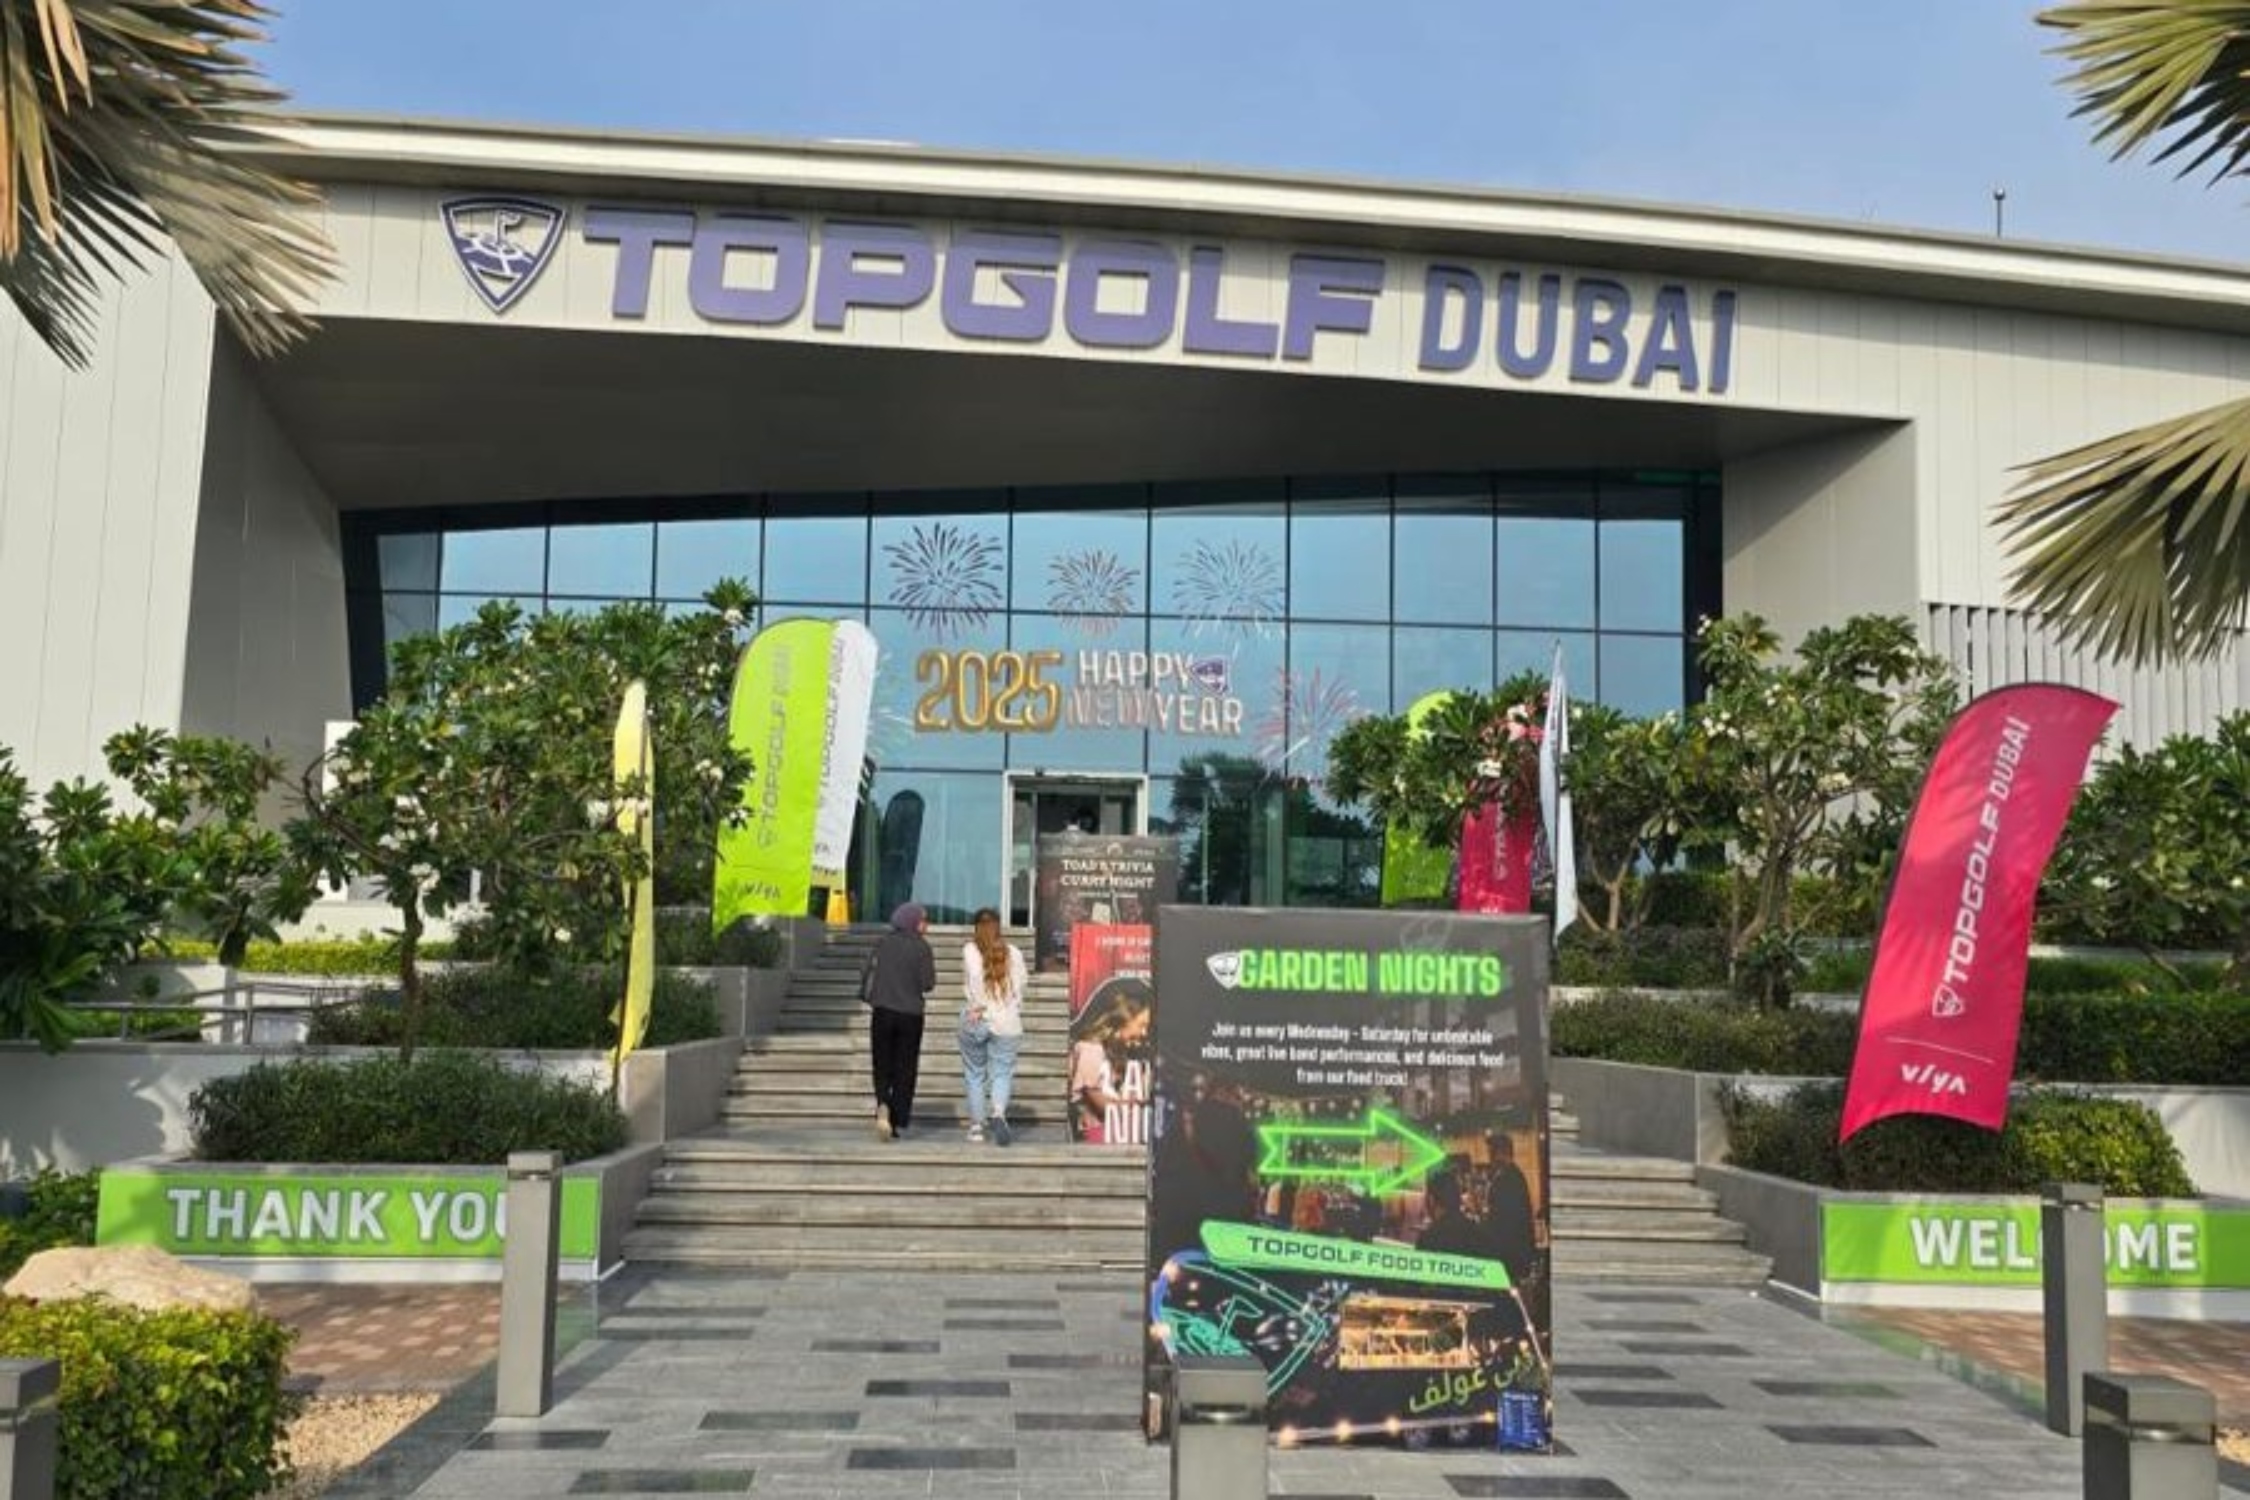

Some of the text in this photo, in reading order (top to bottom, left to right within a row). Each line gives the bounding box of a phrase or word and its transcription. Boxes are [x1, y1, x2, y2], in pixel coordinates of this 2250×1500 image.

[583, 205, 1738, 395] TOPGOLF DUBAI
[916, 649, 1193, 733] 2025 HAPPY
[1151, 693, 1244, 735] YEAR
[1943, 716, 2030, 985] TOPGOLF DUBAI
[1238, 949, 1501, 997] GARDEN NIGHTS
[1237, 1045, 1265, 1062] great
[1320, 1048, 1400, 1066] performances,
[1404, 1051, 1424, 1065] and
[1427, 1051, 1476, 1066] delicious
[1239, 1026, 1252, 1038] us
[1254, 1026, 1285, 1042] every
[1287, 1023, 1349, 1043] Wednesday
[1361, 1027, 1410, 1045] Saturday
[1297, 1067, 1323, 1084] from
[1327, 1071, 1344, 1084] our
[1347, 1069, 1373, 1085] food
[168, 1188, 386, 1241] THANK
[1247, 1236, 1485, 1279] TOPGOLF FOOD TRUCK
[1910, 1217, 2196, 1270] WELME
